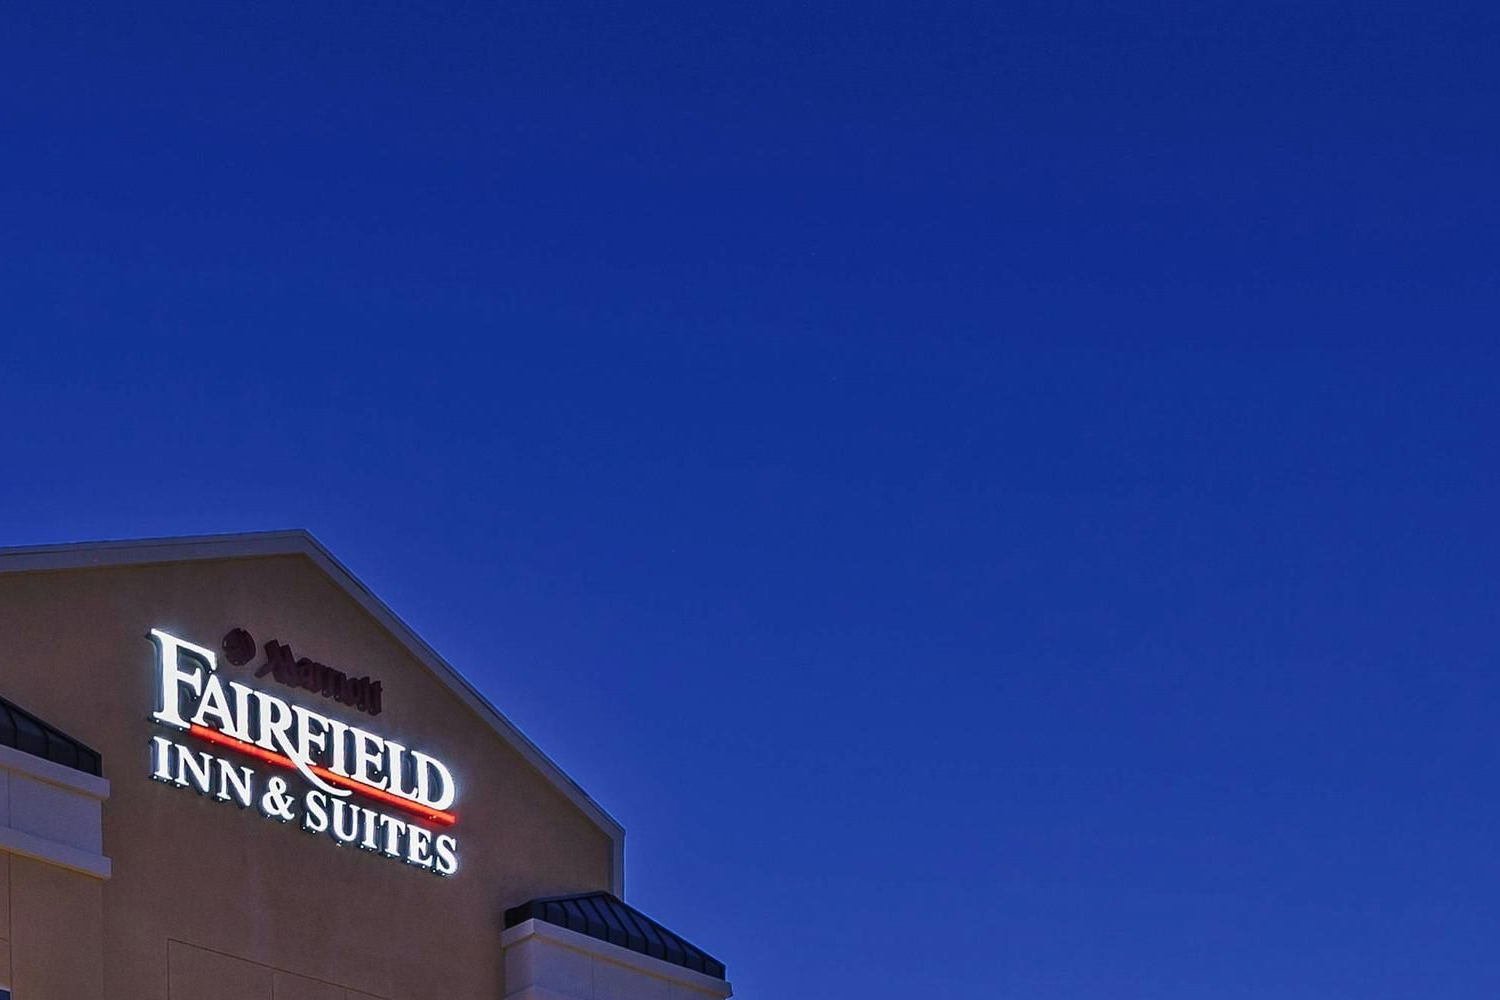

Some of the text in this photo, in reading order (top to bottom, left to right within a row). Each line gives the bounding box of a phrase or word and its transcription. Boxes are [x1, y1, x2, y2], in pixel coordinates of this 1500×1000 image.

[150, 628, 456, 812] FAIRFIELD
[152, 736, 460, 876] INN & SUITES
